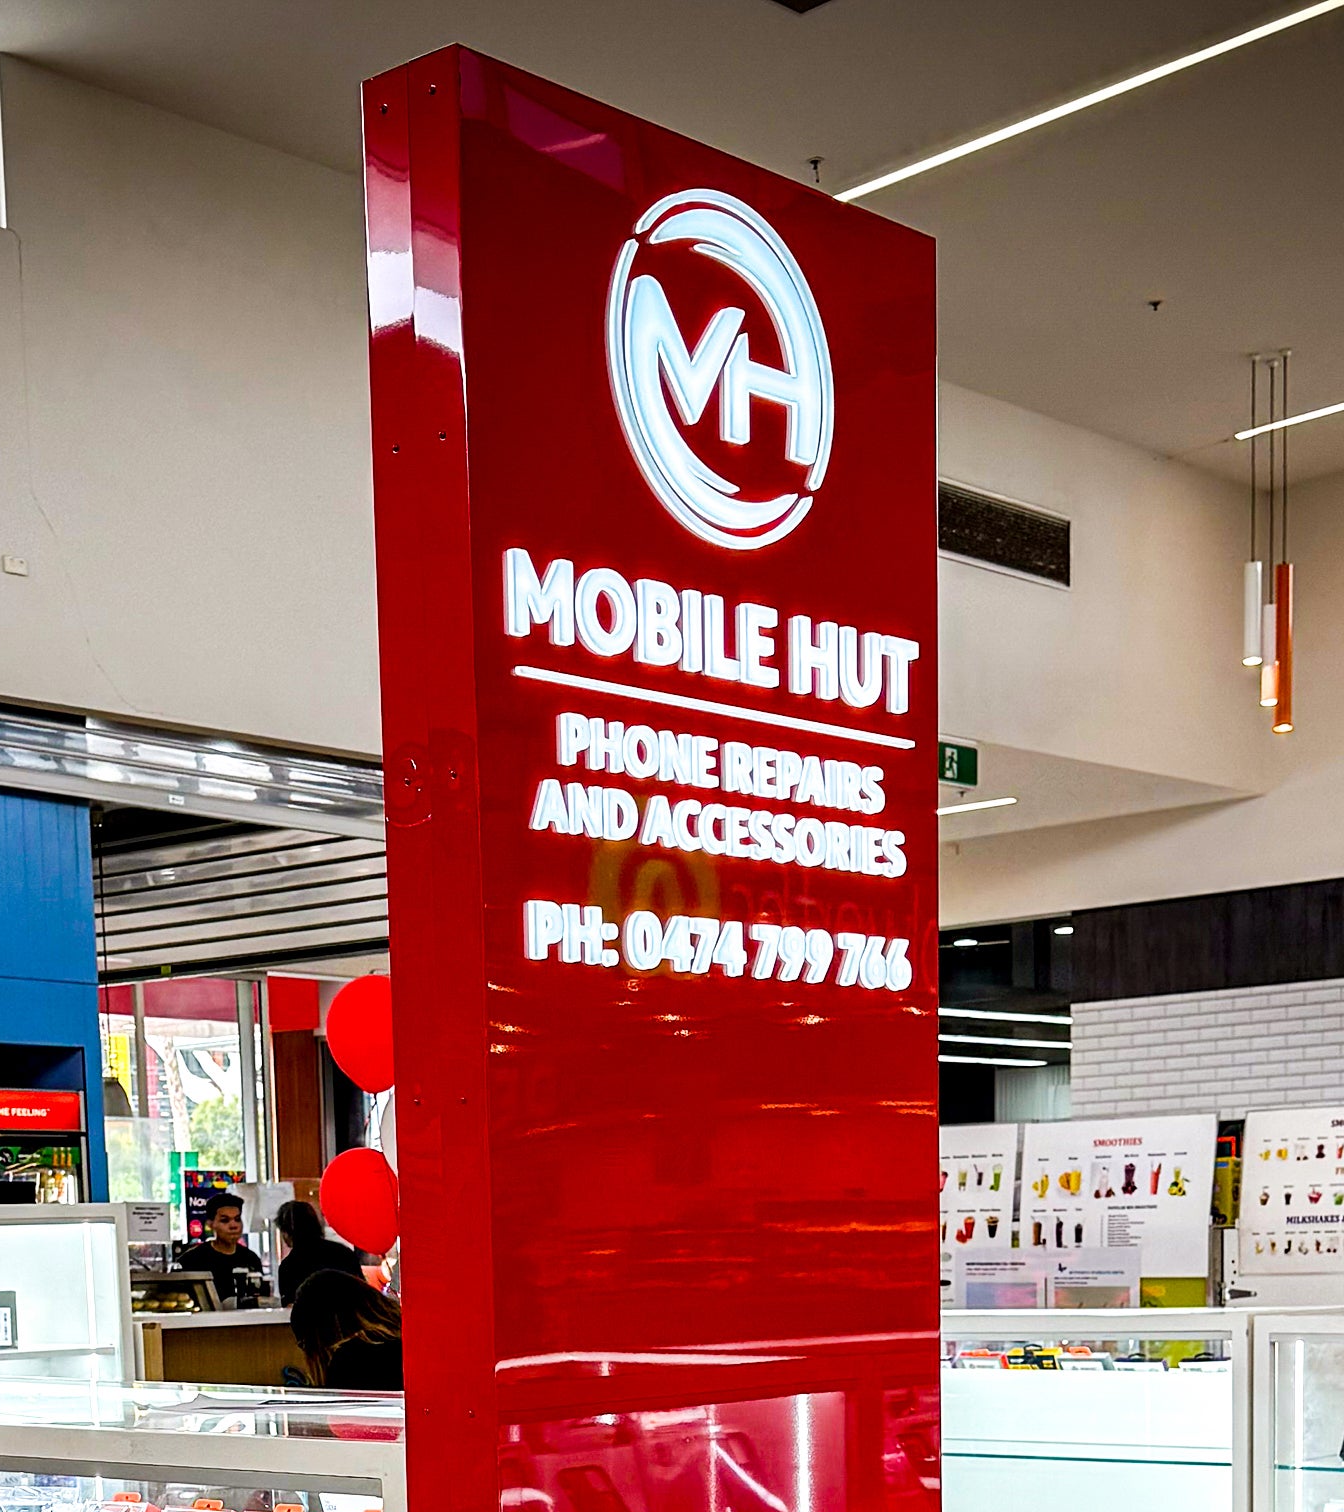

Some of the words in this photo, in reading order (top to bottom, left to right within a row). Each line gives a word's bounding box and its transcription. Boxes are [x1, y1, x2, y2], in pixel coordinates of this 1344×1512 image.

[503, 547, 781, 690] MOBILE
[787, 614, 920, 715] HUT
[556, 712, 720, 791] PHONE
[723, 741, 885, 815] REPAIRS
[530, 779, 640, 843] AND
[642, 795, 908, 879] ACCESSORIES
[524, 899, 620, 968] PH:
[623, 910, 748, 978] 0474
[750, 923, 834, 984] 799
[835, 931, 913, 991] 766
[1093, 1137, 1143, 1148] SMOOTHIES
[1286, 1213, 1340, 1225] MILKSHAKES
